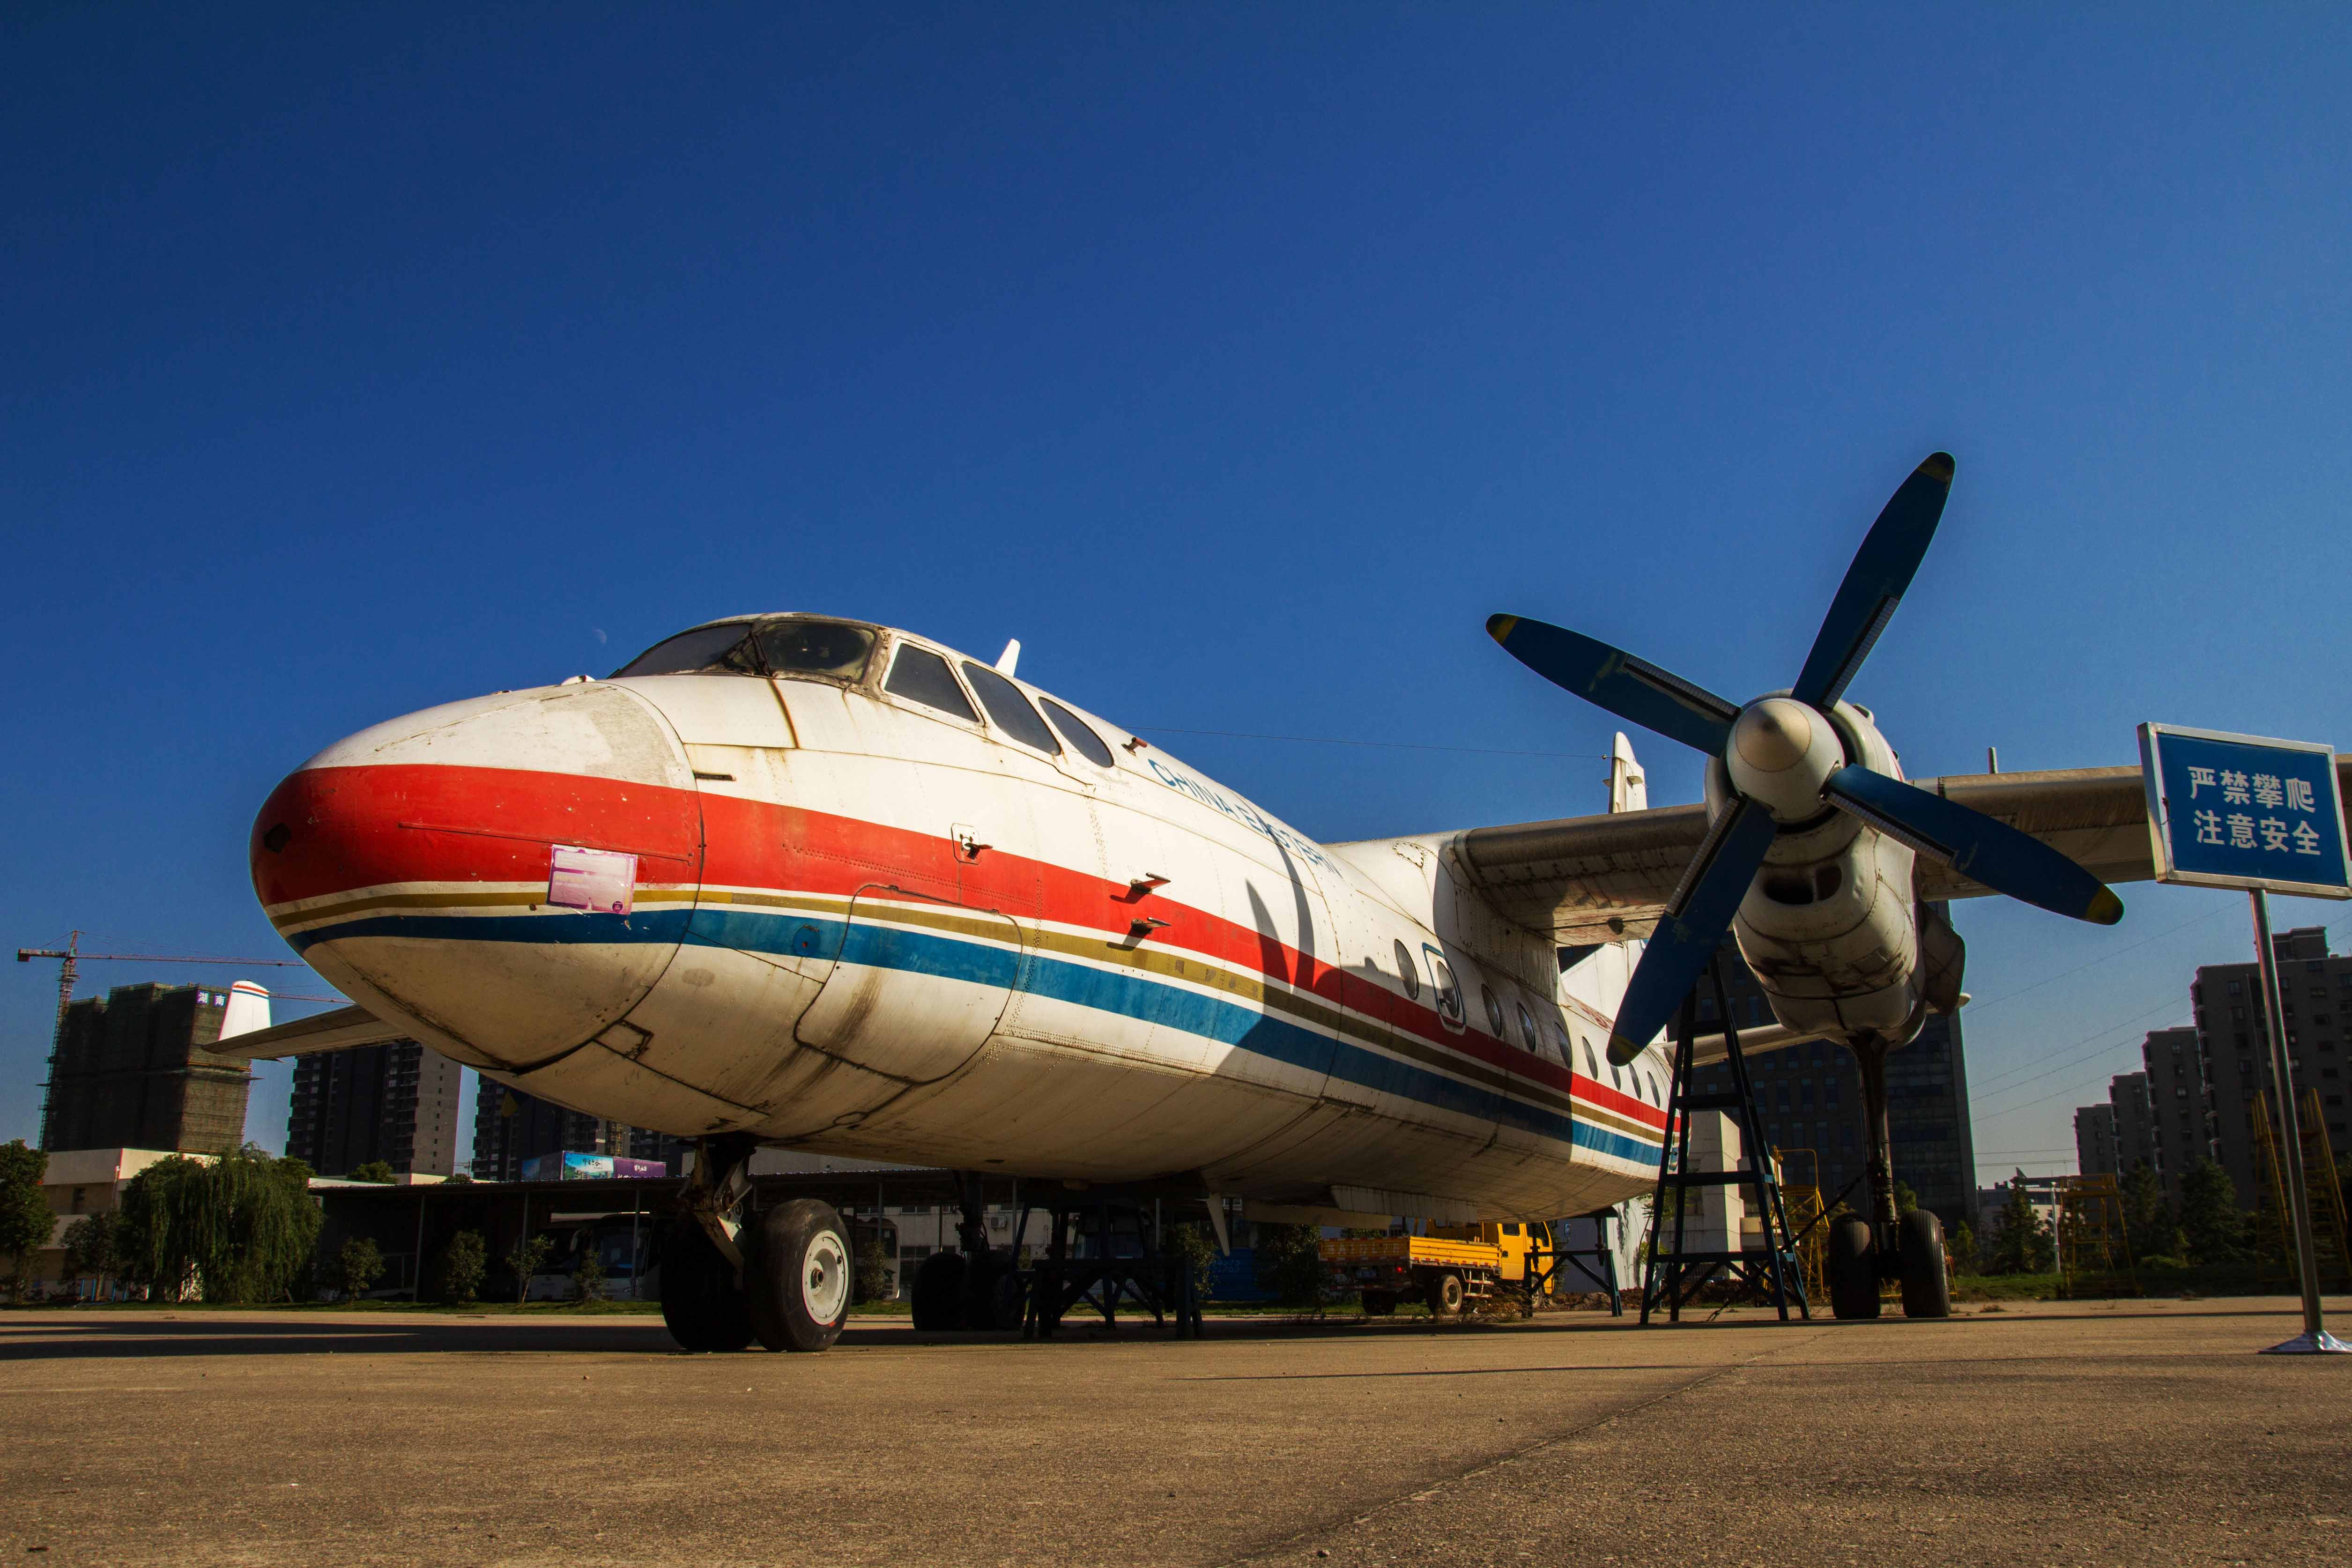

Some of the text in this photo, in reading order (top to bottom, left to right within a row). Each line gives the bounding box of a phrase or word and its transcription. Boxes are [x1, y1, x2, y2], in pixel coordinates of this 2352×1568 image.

[2188, 766, 2316, 813] 严禁攀爬
[1148, 758, 1343, 878] CHINA EASTERN
[2193, 810, 2321, 855] 注意安全
